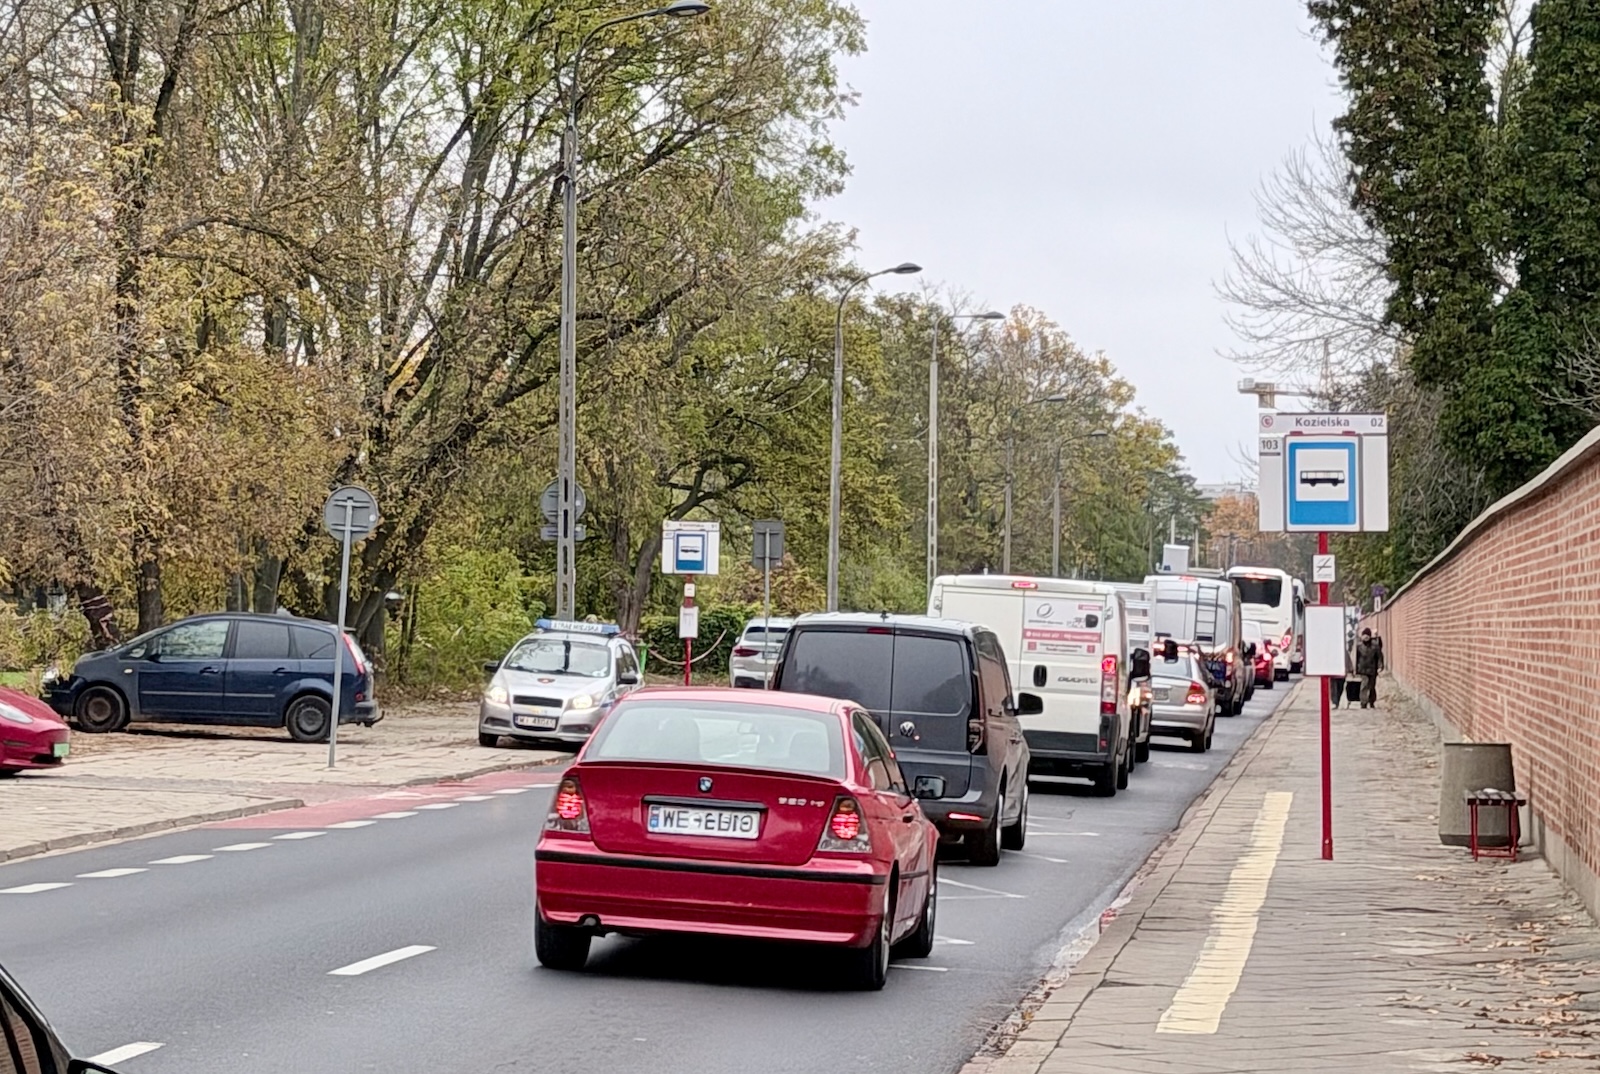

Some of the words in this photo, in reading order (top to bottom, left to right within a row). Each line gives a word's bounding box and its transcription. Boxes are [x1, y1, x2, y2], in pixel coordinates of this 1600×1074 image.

[1295, 417, 1350, 427] Kozielska
[1370, 418, 1384, 427] 02
[1261, 440, 1278, 450] 103
